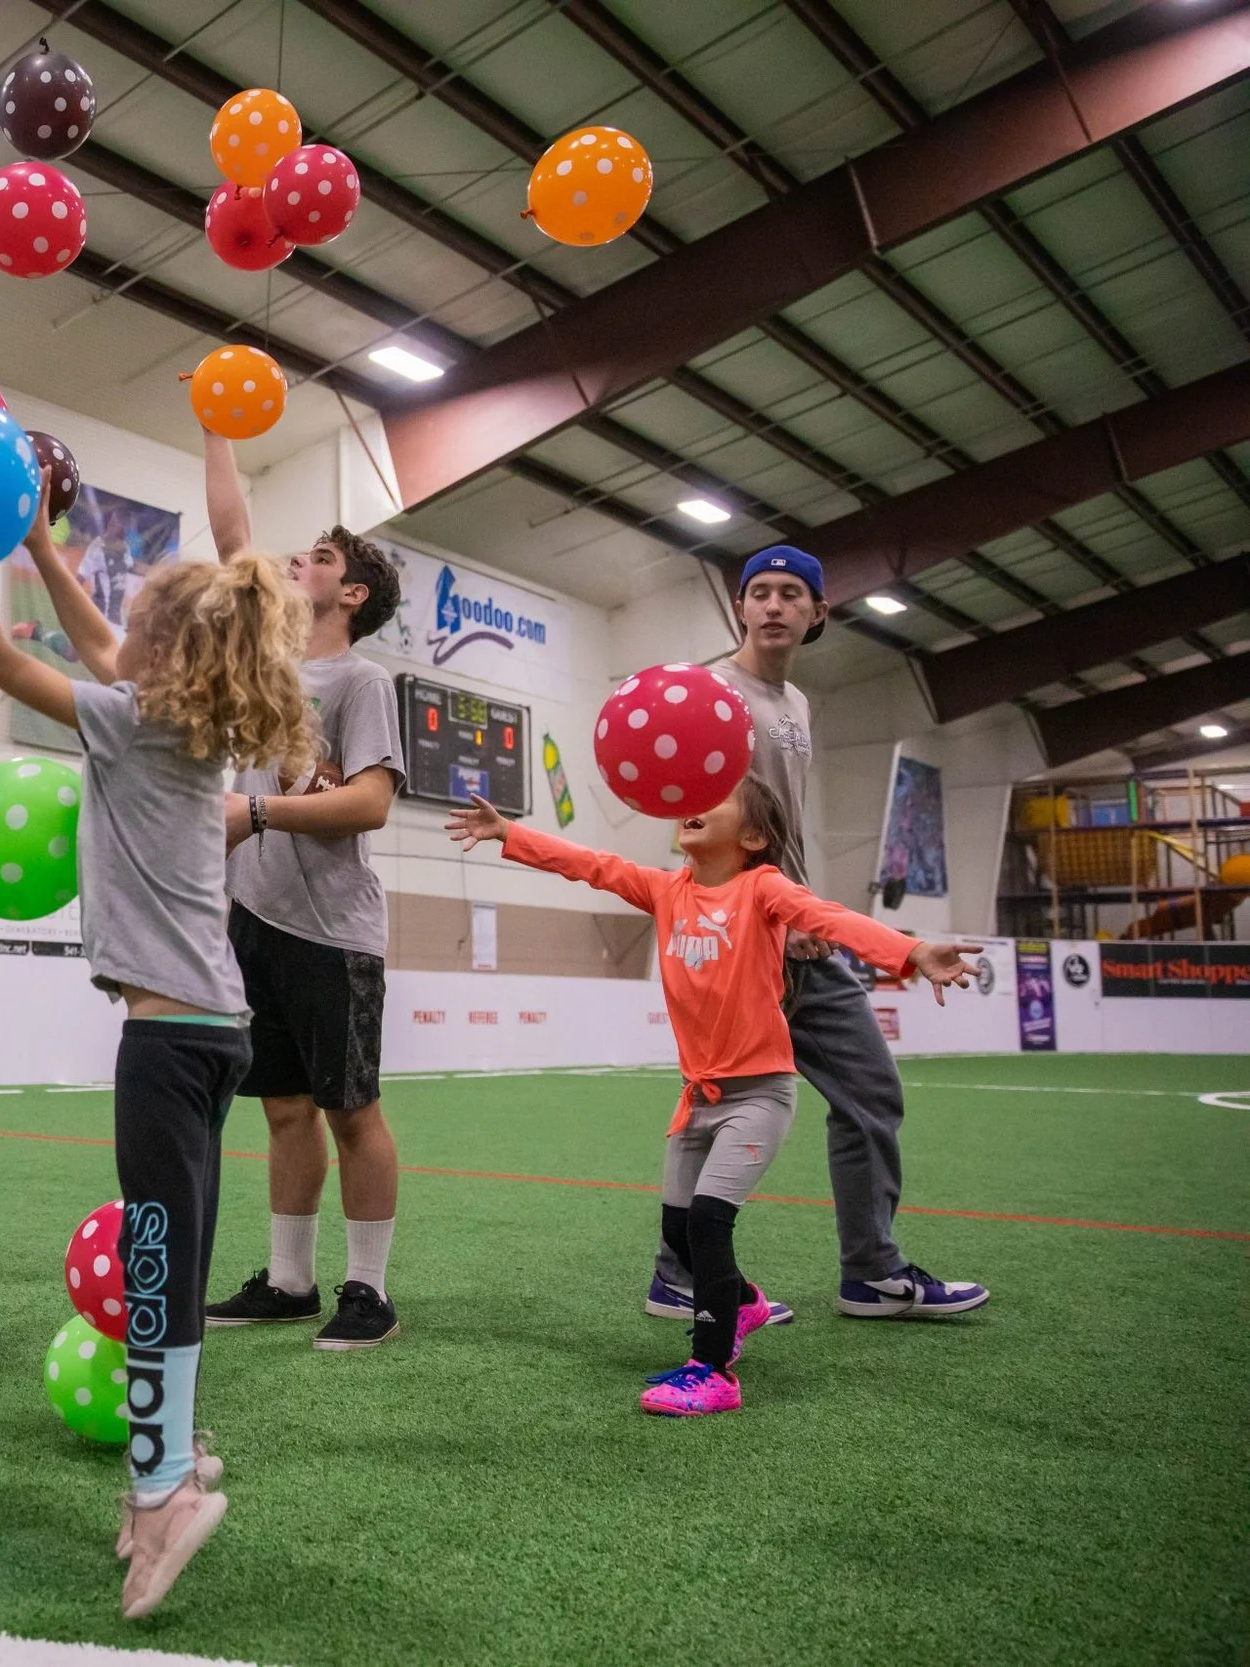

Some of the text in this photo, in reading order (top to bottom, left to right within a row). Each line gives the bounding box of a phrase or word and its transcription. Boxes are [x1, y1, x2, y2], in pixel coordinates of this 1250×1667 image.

[1102, 959, 1163, 979] Smart
[413, 1010, 446, 1025] PENALTY
[468, 1011, 498, 1025] REFEREE
[518, 1011, 547, 1025] PENALTY
[126, 1202, 168, 1477] adidas
